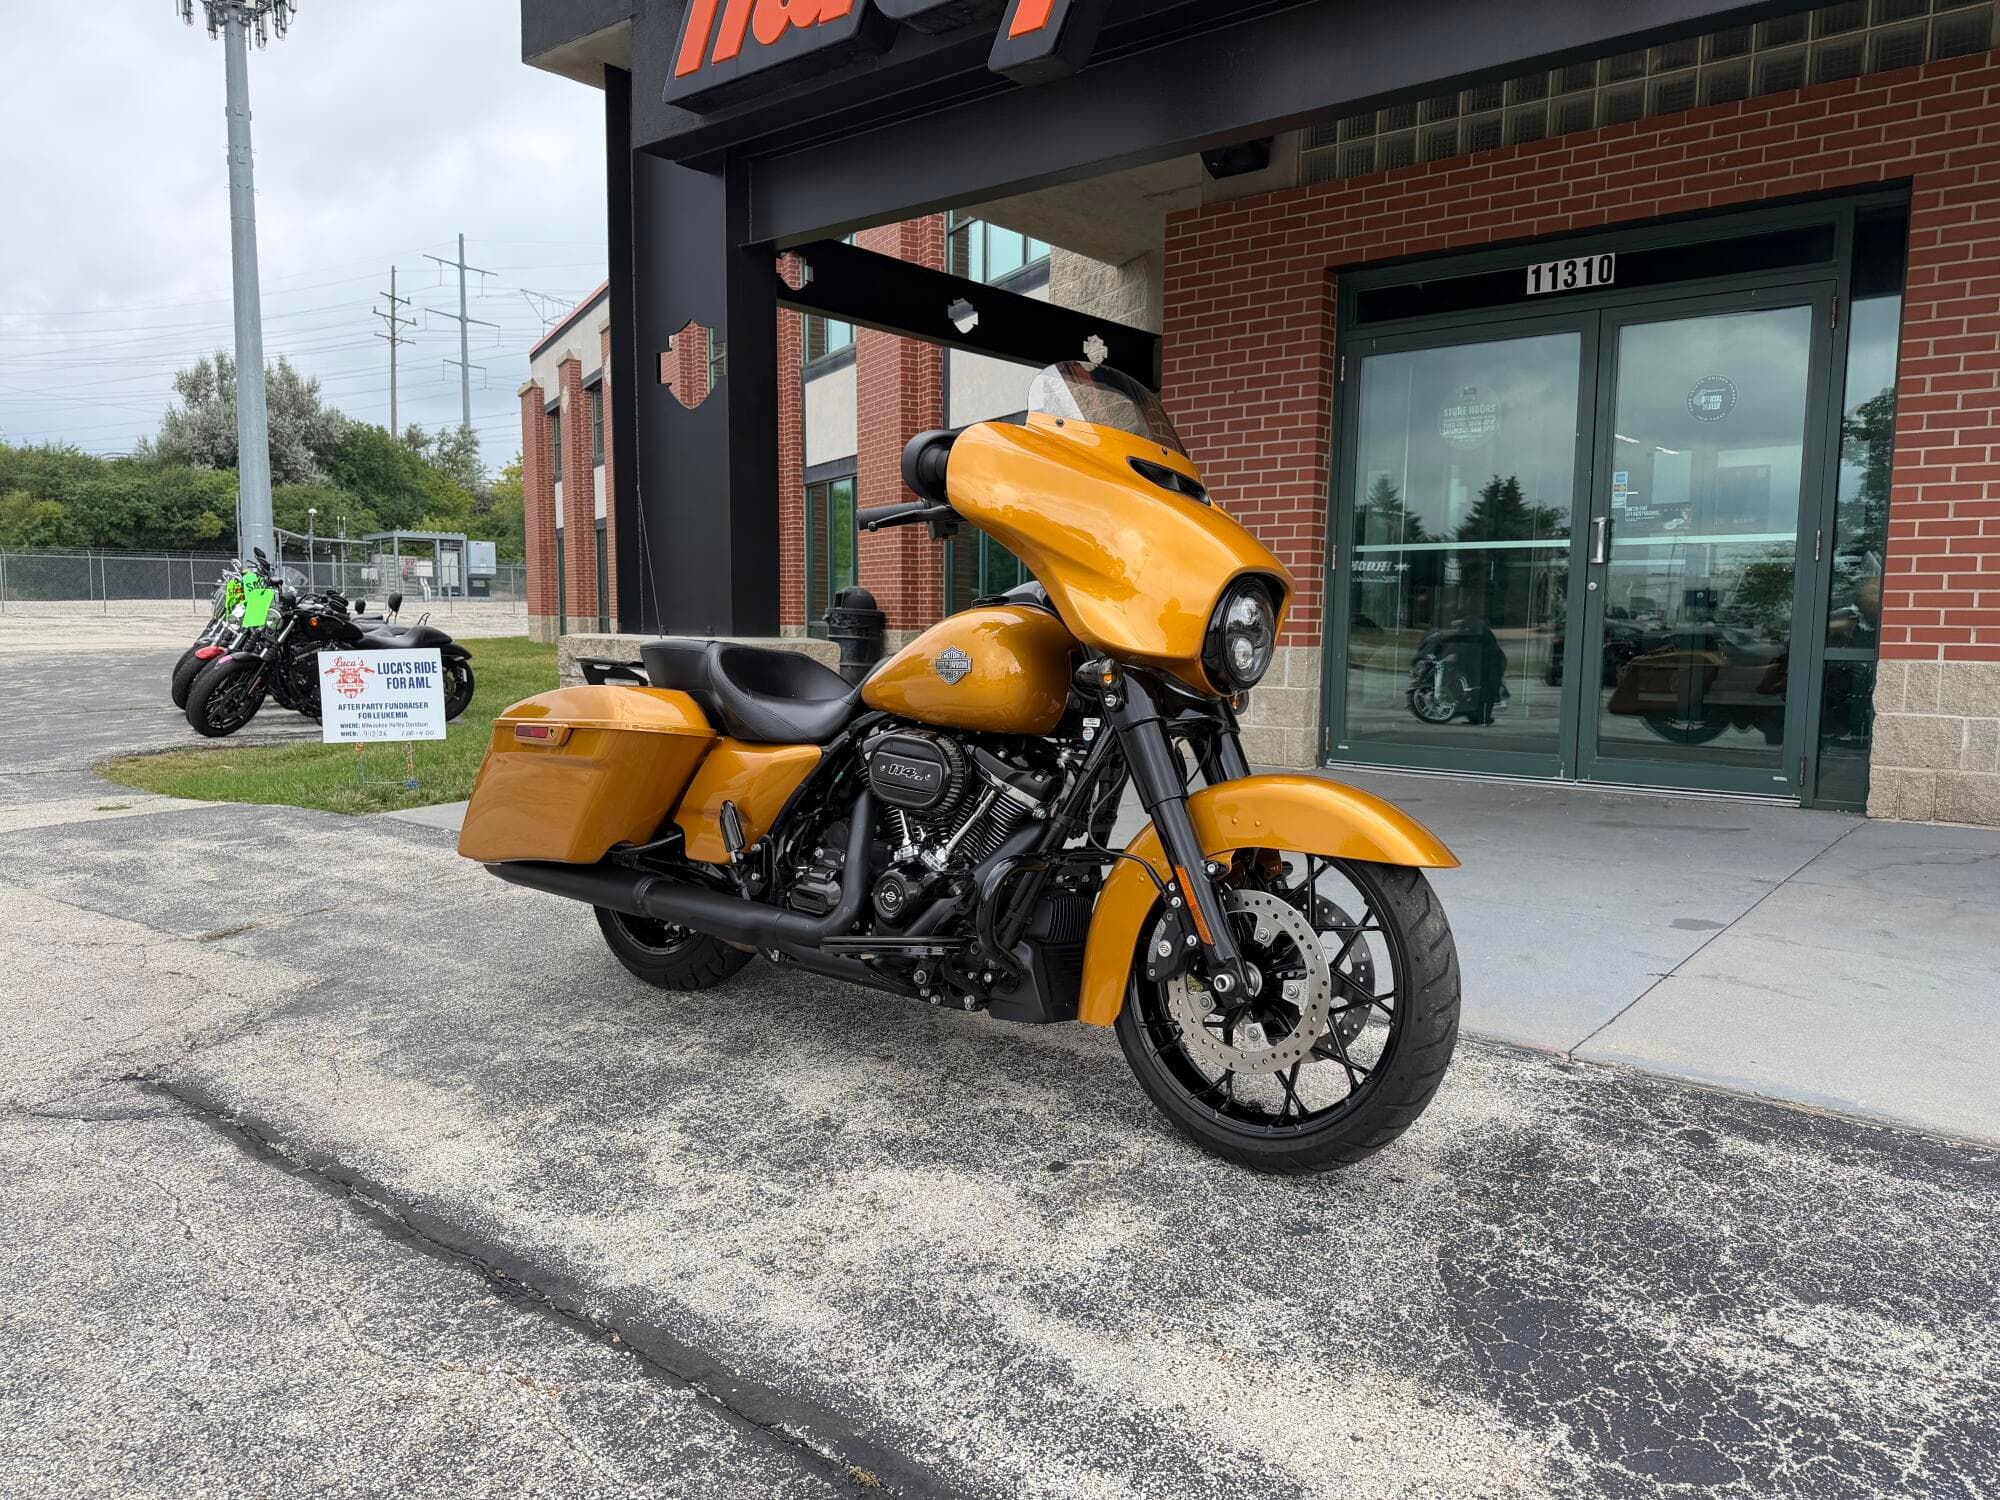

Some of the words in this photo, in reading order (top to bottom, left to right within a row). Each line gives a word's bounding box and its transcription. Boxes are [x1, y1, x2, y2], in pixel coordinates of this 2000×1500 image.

[1531, 254, 1613, 293] 11310
[1443, 406, 1468, 417] STORE
[1468, 403, 1496, 415] HOURS
[334, 656, 365, 667] Luca's
[377, 661, 412, 675] LUCA'S
[414, 661, 438, 674] RIDE
[386, 677, 408, 689] FOR
[408, 676, 432, 689] AML
[338, 703, 361, 711] AFTER
[361, 702, 383, 711] PARTY
[384, 701, 429, 710] FUNDRAISER
[358, 712, 373, 720] FOR
[373, 711, 408, 719] LEUKEMIA
[888, 763, 916, 779] 114
